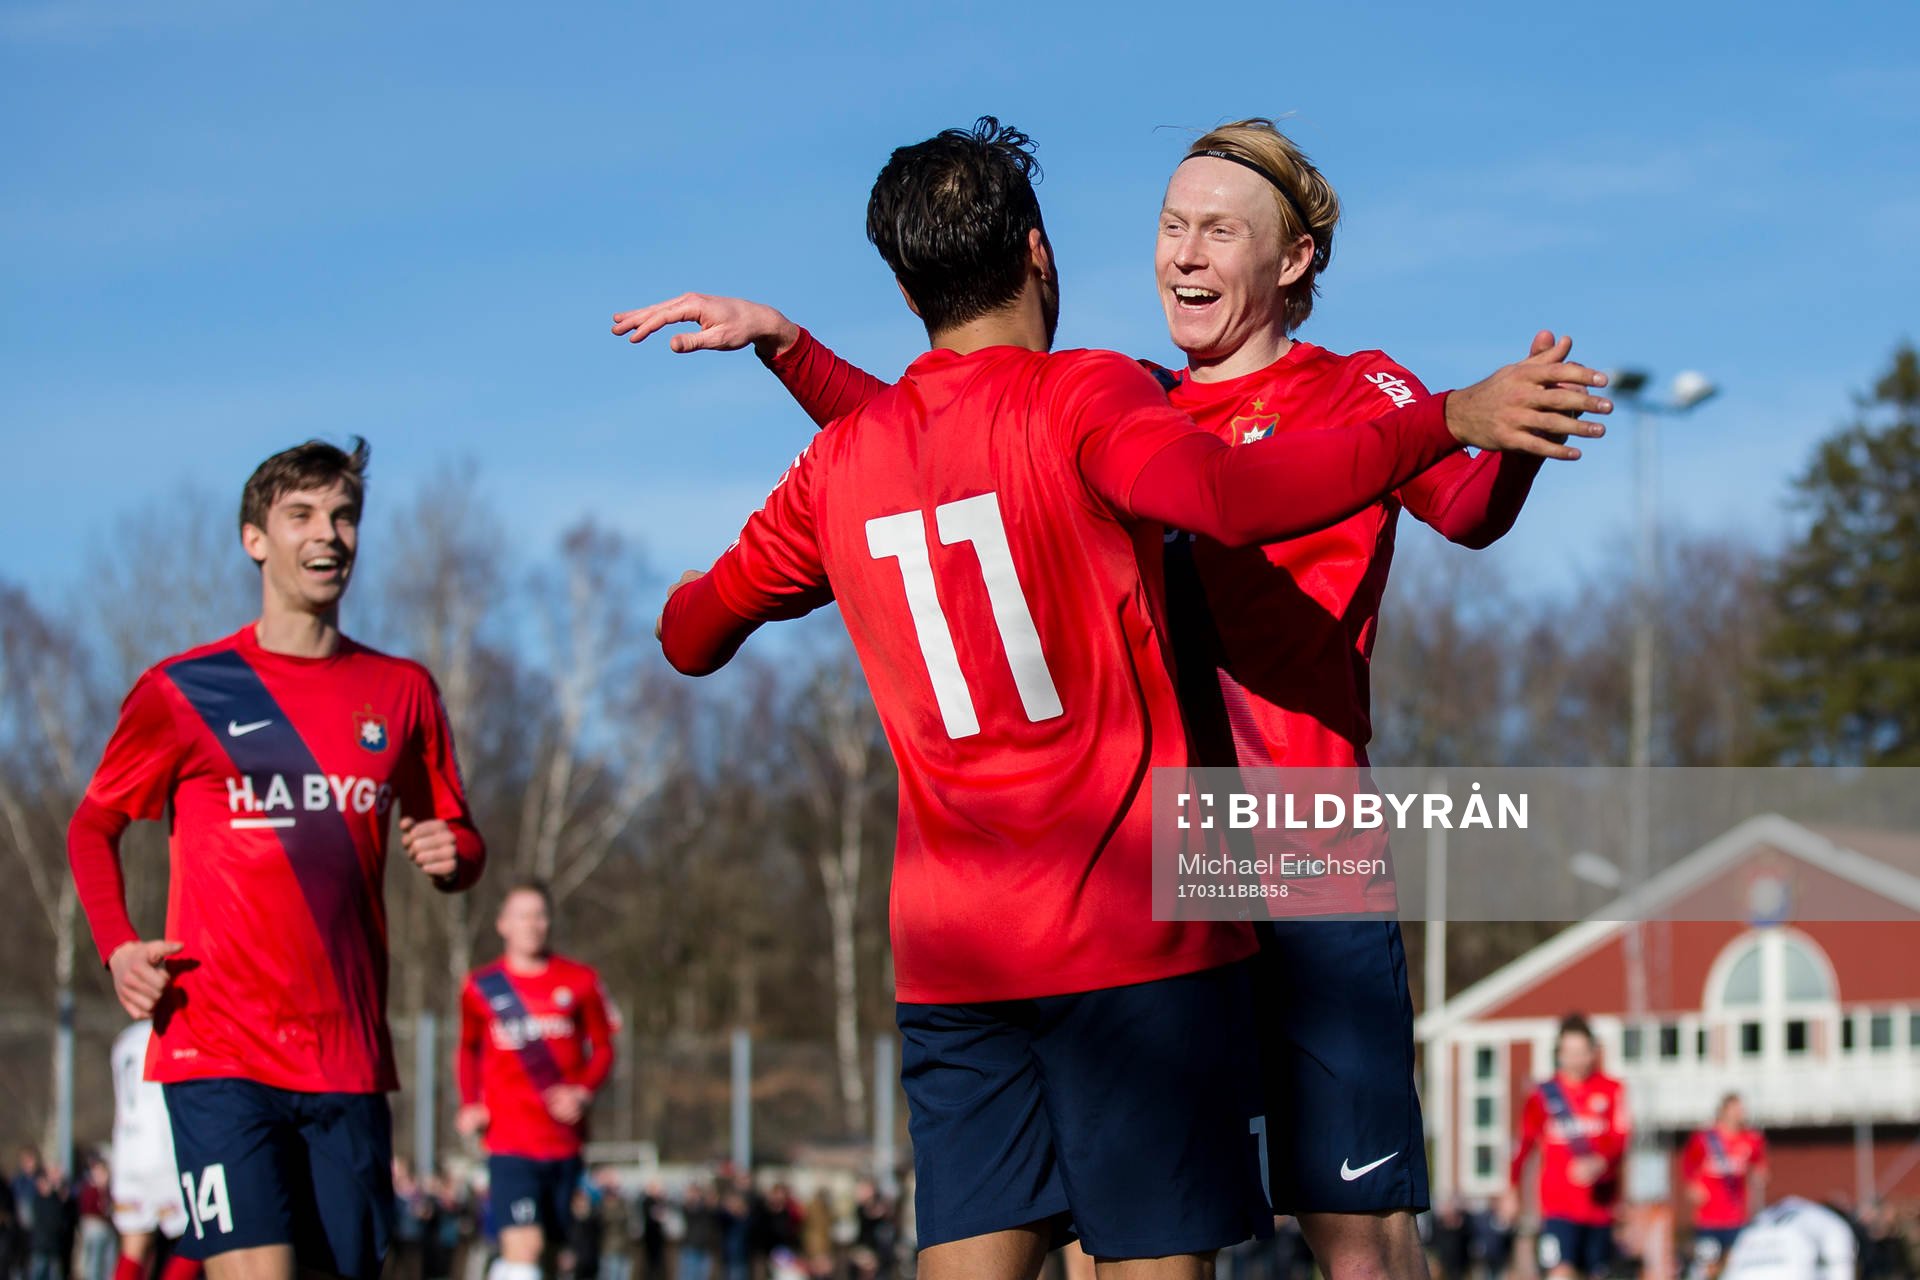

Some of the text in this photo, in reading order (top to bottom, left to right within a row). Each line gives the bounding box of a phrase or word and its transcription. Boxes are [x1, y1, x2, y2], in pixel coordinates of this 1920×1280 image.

[1206, 149, 1227, 158] NIKE
[865, 491, 1064, 740] 11
[226, 773, 295, 813] H.A
[181, 1162, 234, 1240] 14
